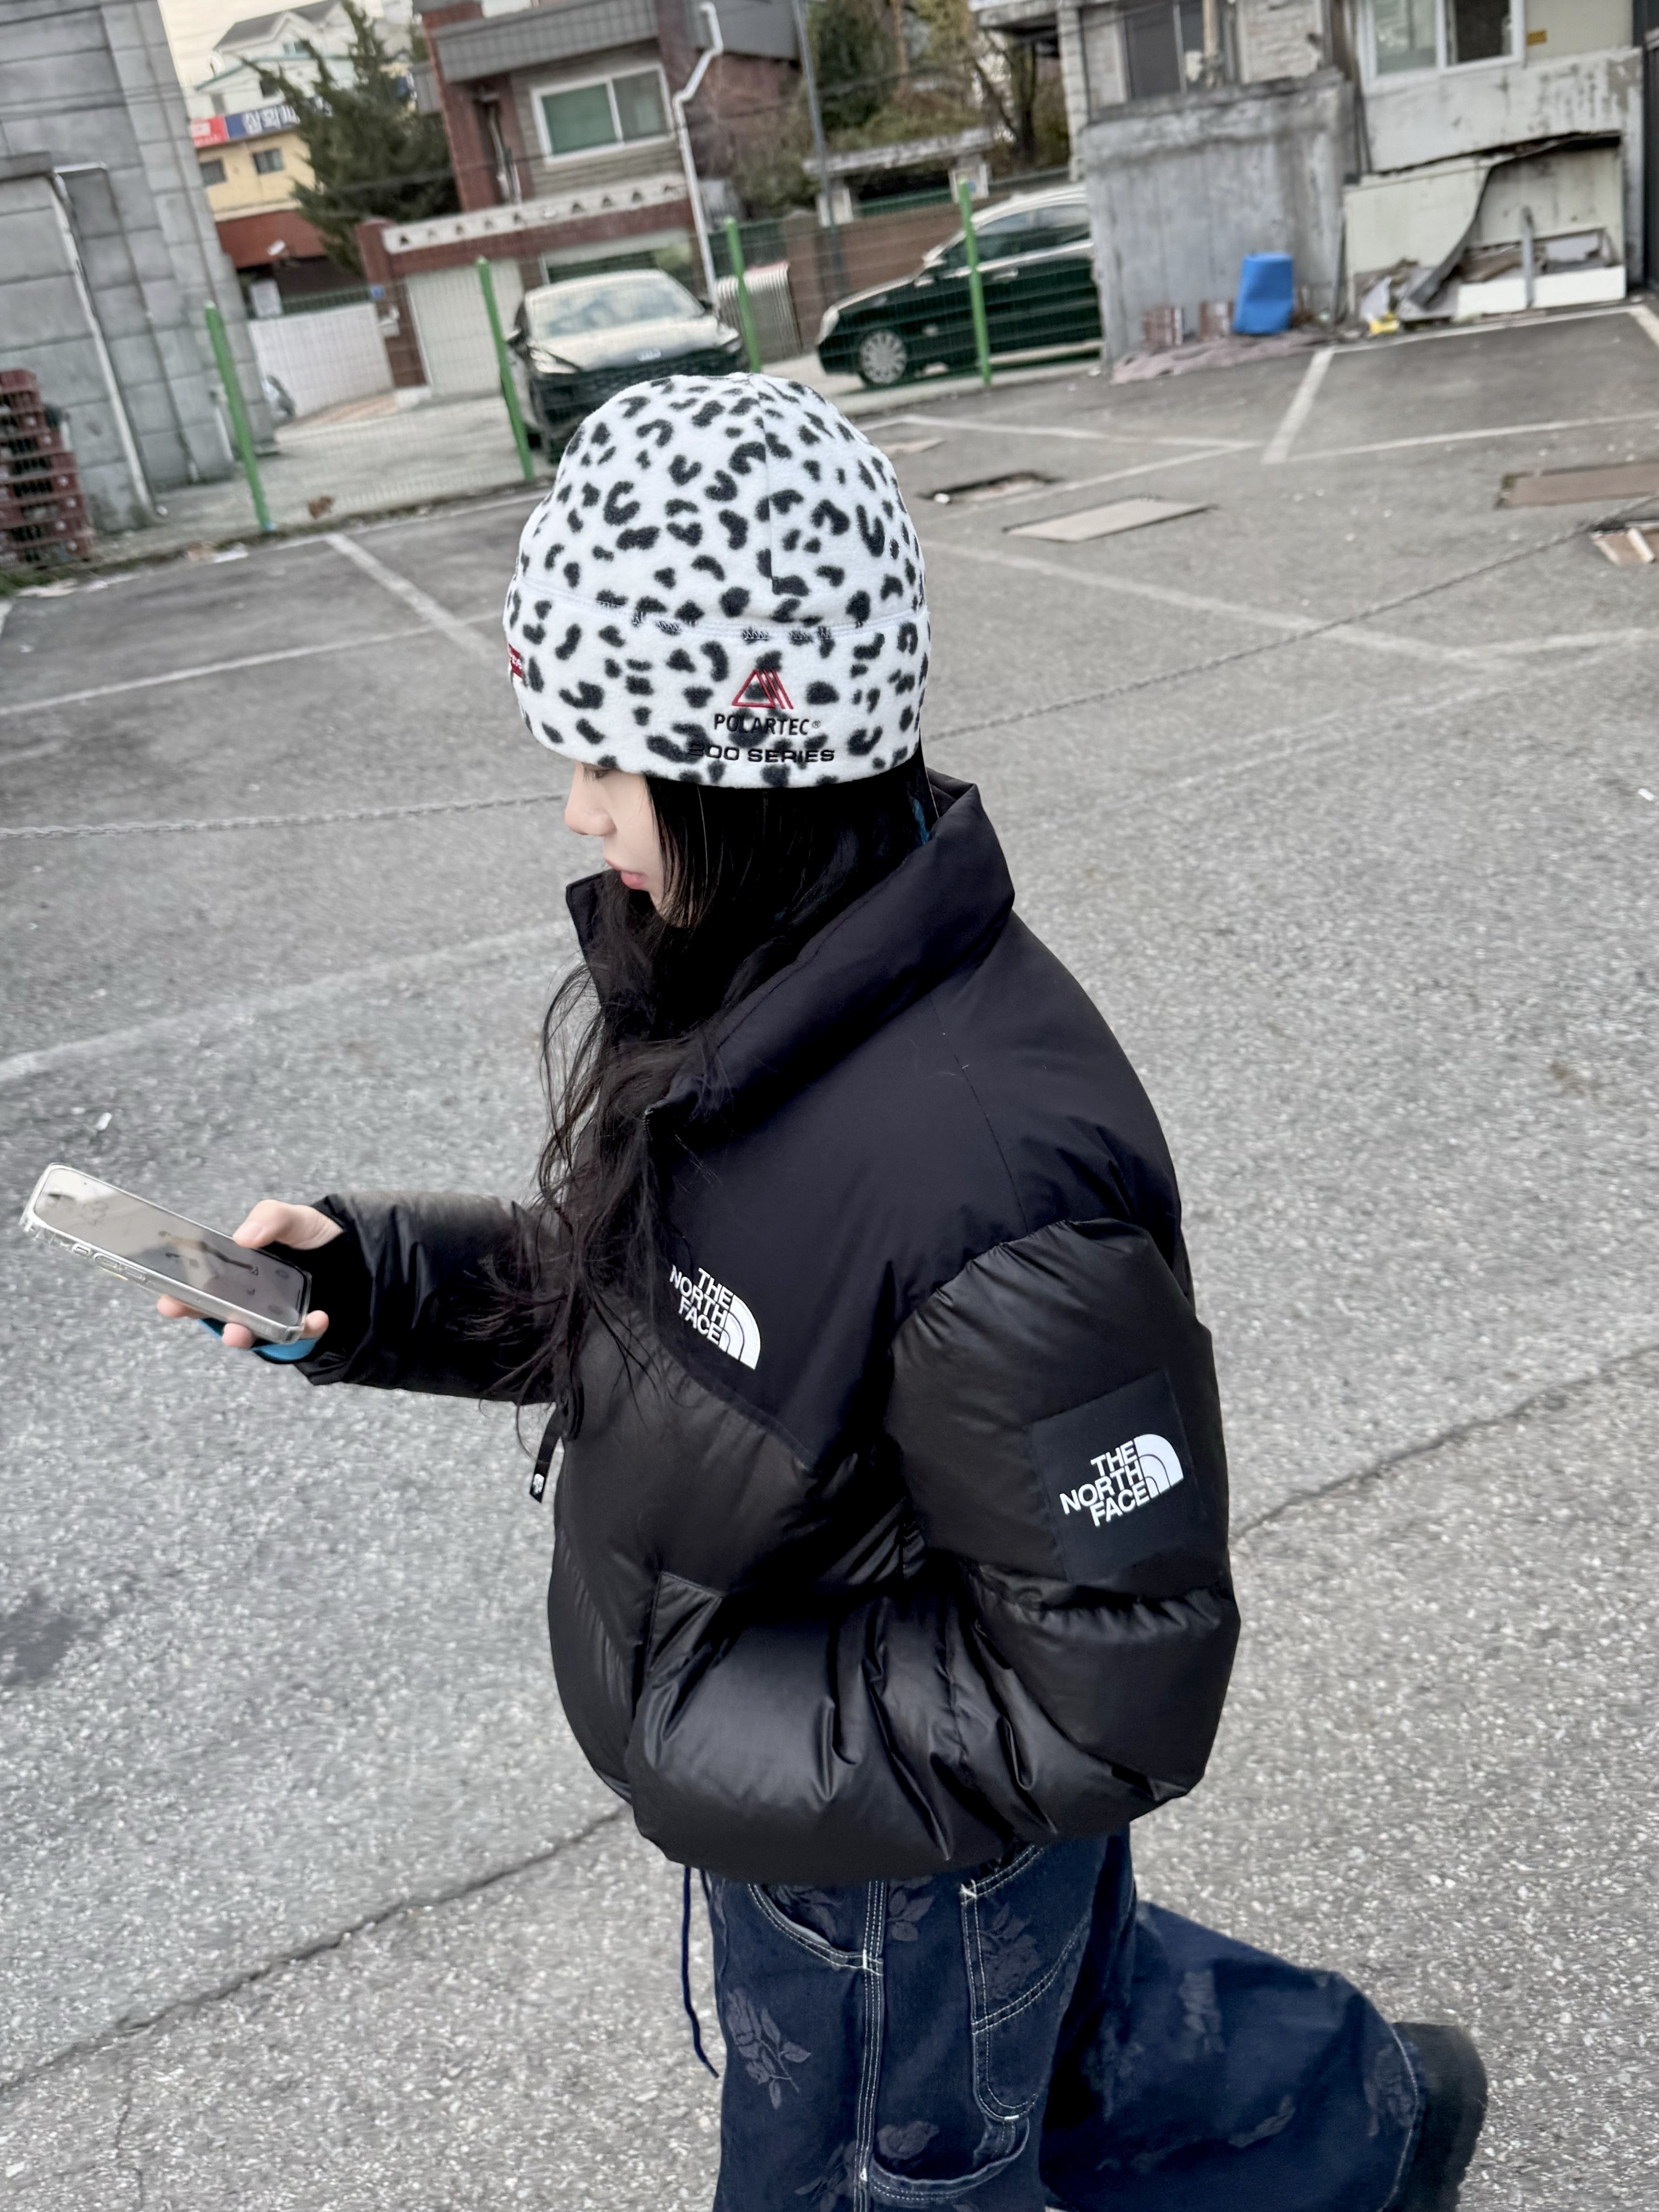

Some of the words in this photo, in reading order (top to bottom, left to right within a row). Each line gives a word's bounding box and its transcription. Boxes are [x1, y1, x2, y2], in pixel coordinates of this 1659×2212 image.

[747, 748, 835, 763] SERIES
[669, 1264, 729, 1329] NORTH
[698, 1267, 734, 1310] THE
[678, 1296, 724, 1345] FACE
[1090, 1440, 1138, 1477] THE
[1059, 1459, 1144, 1515] NORTH
[1089, 1480, 1150, 1528] FACE
